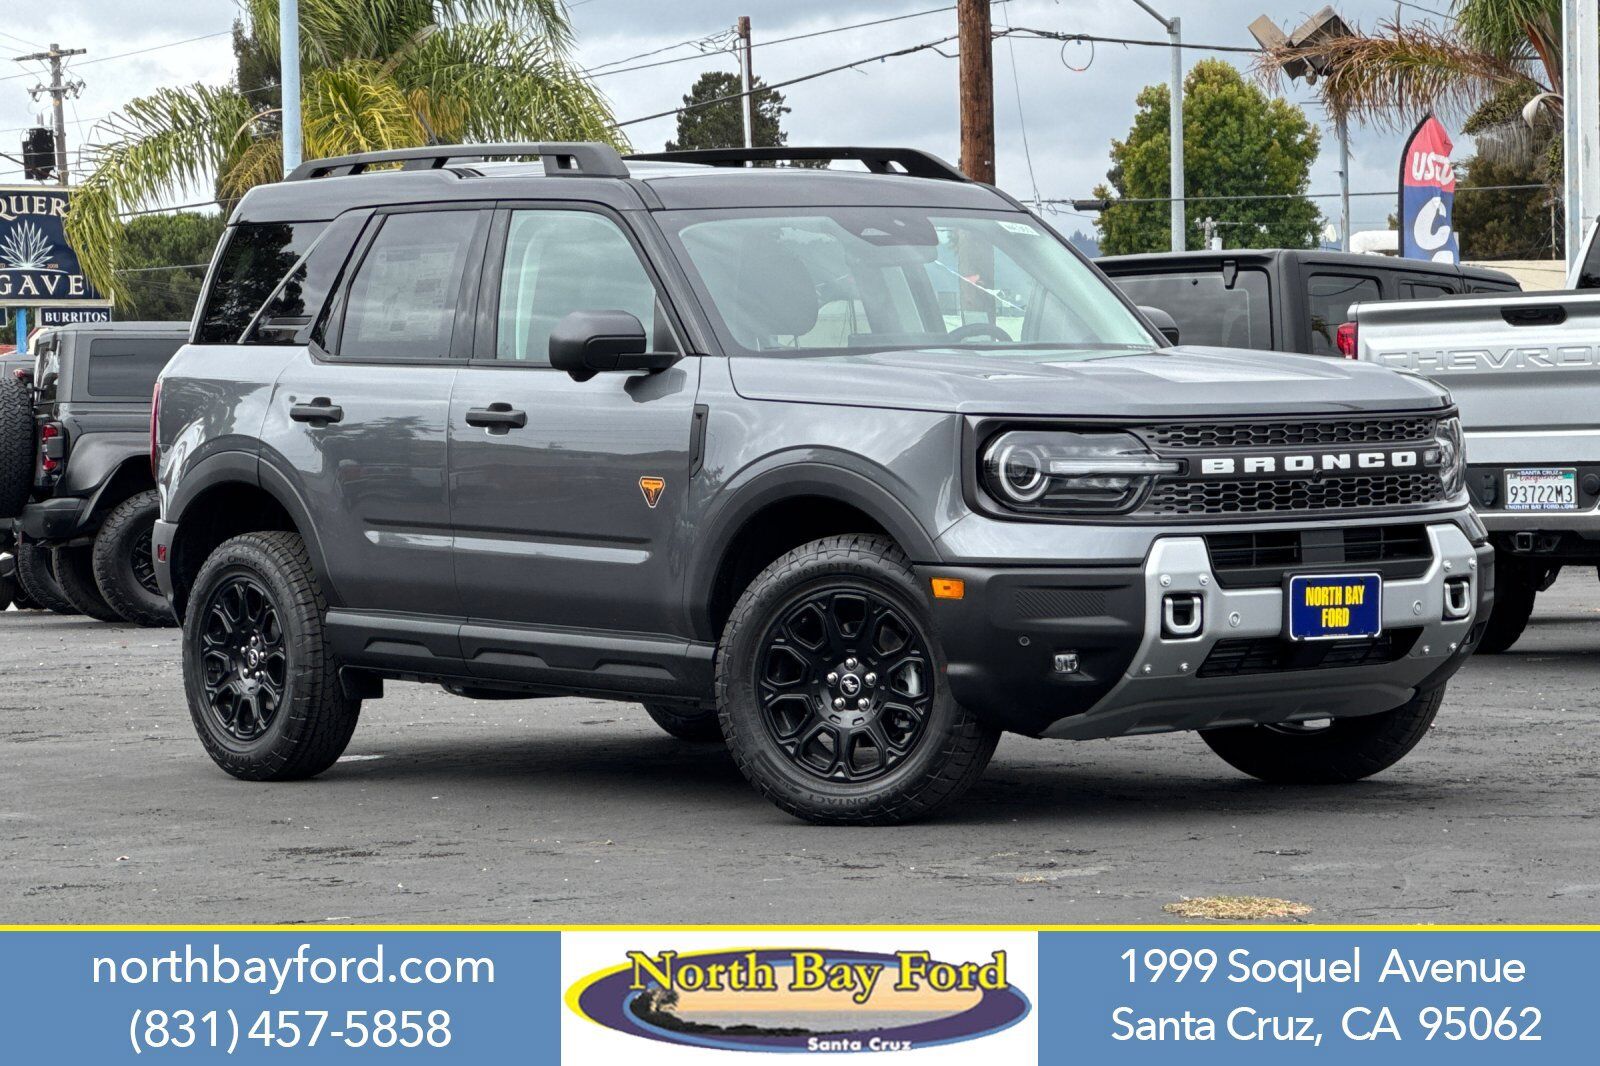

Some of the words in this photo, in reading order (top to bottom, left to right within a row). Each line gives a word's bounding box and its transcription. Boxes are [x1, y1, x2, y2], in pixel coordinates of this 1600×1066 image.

[45, 311, 108, 322] BURRITOS
[1379, 345, 1600, 372] CHEVRO
[1201, 451, 1417, 474] BRONCO
[1510, 485, 1573, 503] 93722M3
[1305, 586, 1343, 606] NORTH
[1344, 585, 1365, 605] BAY
[1321, 607, 1350, 628] FORD
